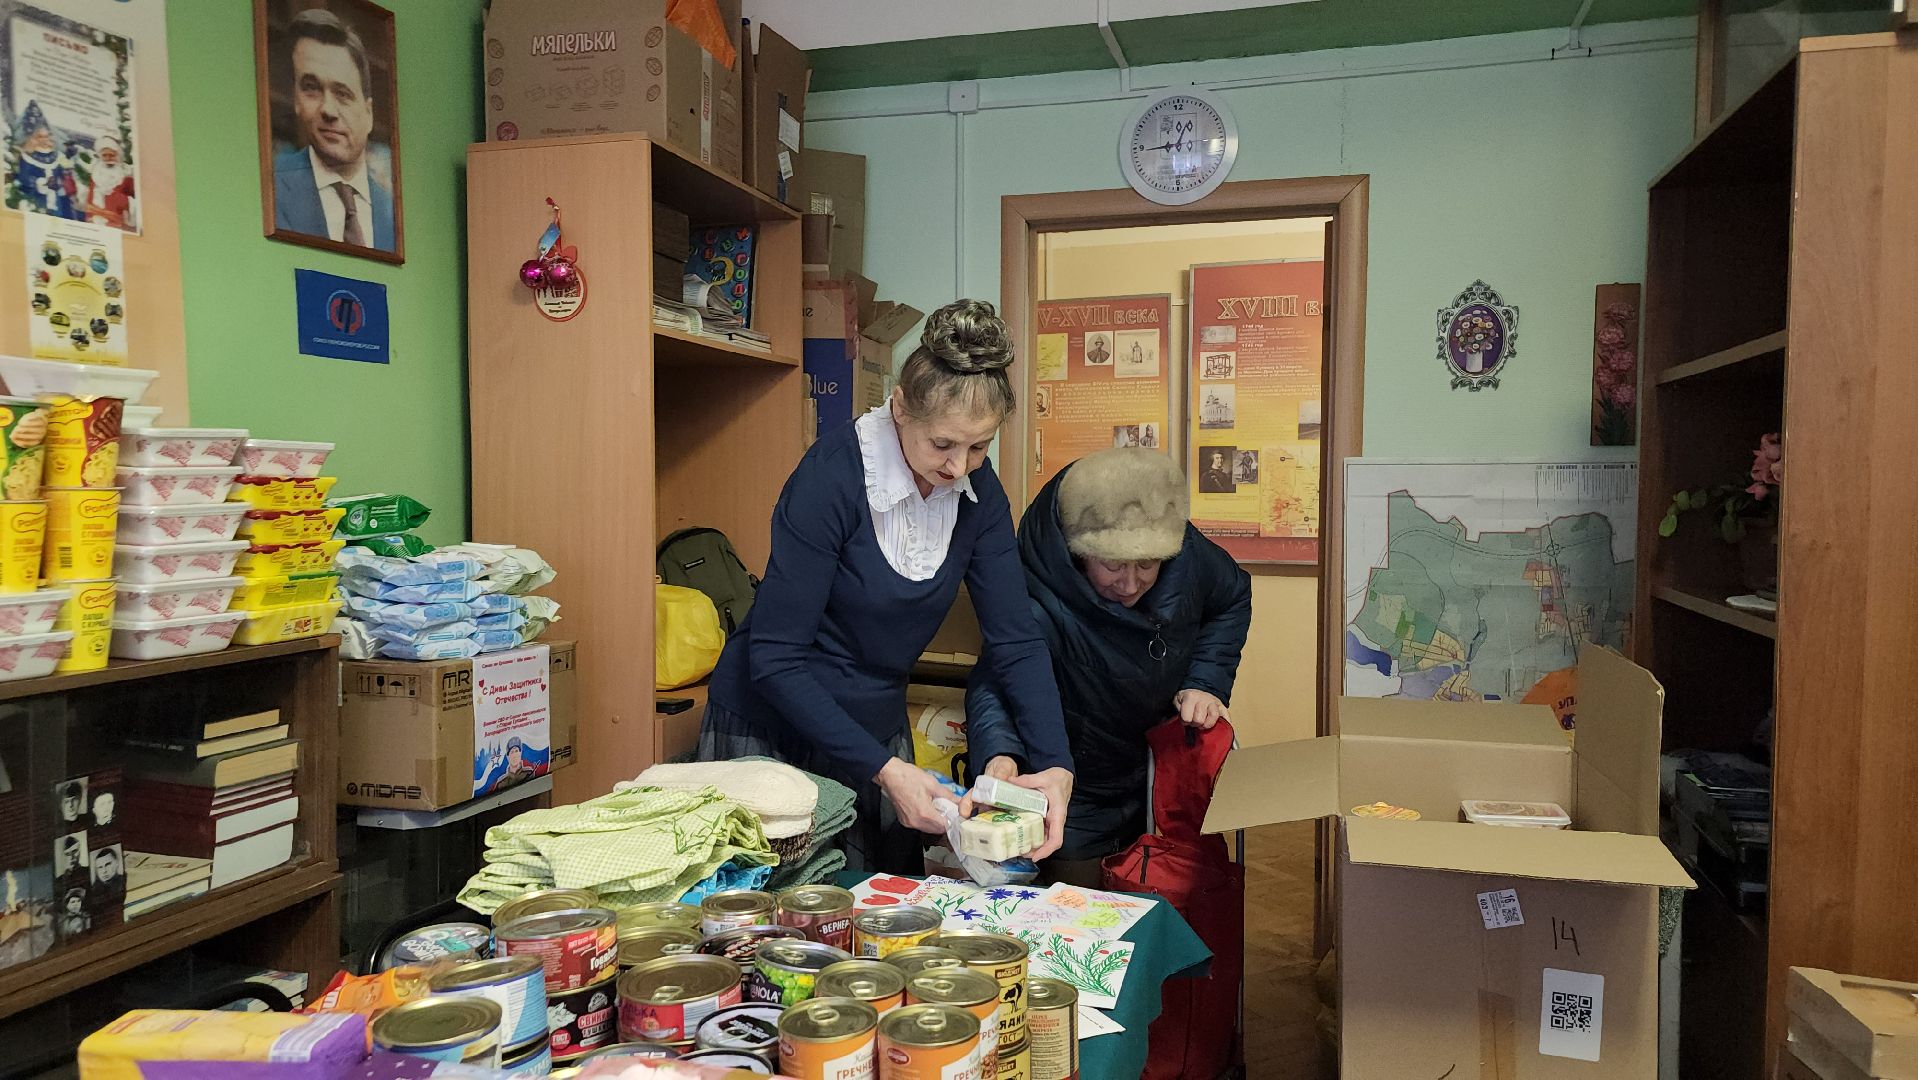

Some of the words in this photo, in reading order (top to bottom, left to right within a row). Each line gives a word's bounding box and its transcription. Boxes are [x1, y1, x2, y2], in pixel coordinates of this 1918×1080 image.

[1217, 295, 1299, 319] XVIII
[442, 669, 473, 692] MR
[482, 687, 489, 695] С
[509, 677, 542, 690] Защитника
[360, 782, 421, 800] MIDAS
[1552, 916, 1580, 956] 14
